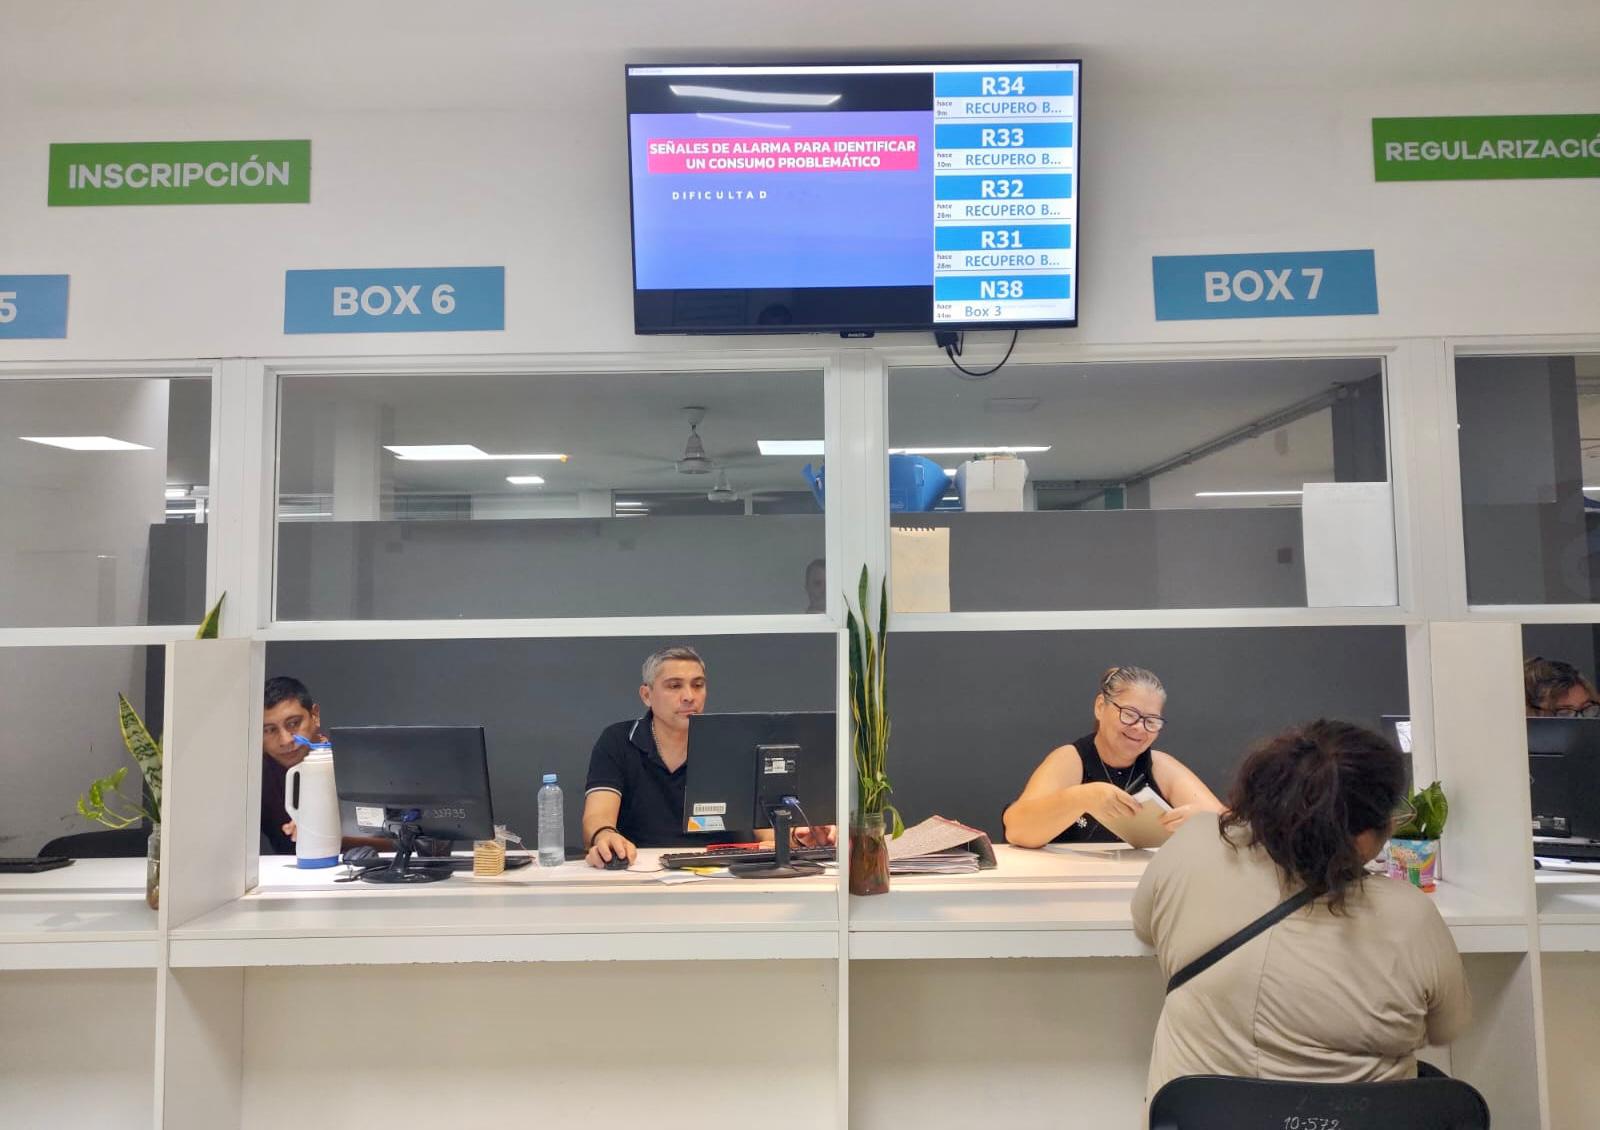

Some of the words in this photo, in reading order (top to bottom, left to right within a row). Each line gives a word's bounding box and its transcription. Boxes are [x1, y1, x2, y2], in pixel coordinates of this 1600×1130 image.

[981, 77, 1025, 95] R34
[965, 101, 1037, 114] RECUPERO
[1042, 101, 1062, 114] B...
[981, 128, 1024, 147] R33
[649, 140, 710, 155] SEÑALES
[712, 141, 730, 154] DE
[732, 141, 791, 154] ALARMA
[794, 141, 830, 153] PARA
[833, 140, 917, 153] IDENTIFICAR
[686, 157, 706, 170] UN
[709, 157, 775, 169] CONSUMO
[778, 153, 881, 168] PROBLEMÁTICO
[965, 153, 1037, 166] RECUPERO
[1041, 153, 1061, 165] B...
[68, 155, 290, 190] INSCRIPCIÓN
[981, 180, 1024, 198] R32
[965, 204, 1036, 217] RECUPERO
[1041, 204, 1061, 216] B...
[981, 230, 1023, 248] R31
[964, 254, 1035, 267] RECUPERO
[1040, 254, 1060, 266] B...
[980, 280, 1024, 298] N38
[1204, 268, 1294, 304] BOX
[1301, 267, 1324, 300] 7
[0, 291, 17, 323] 5
[332, 285, 422, 317] BOX
[430, 283, 456, 315] 6
[965, 305, 989, 318] Box
[994, 305, 1002, 316] 3
